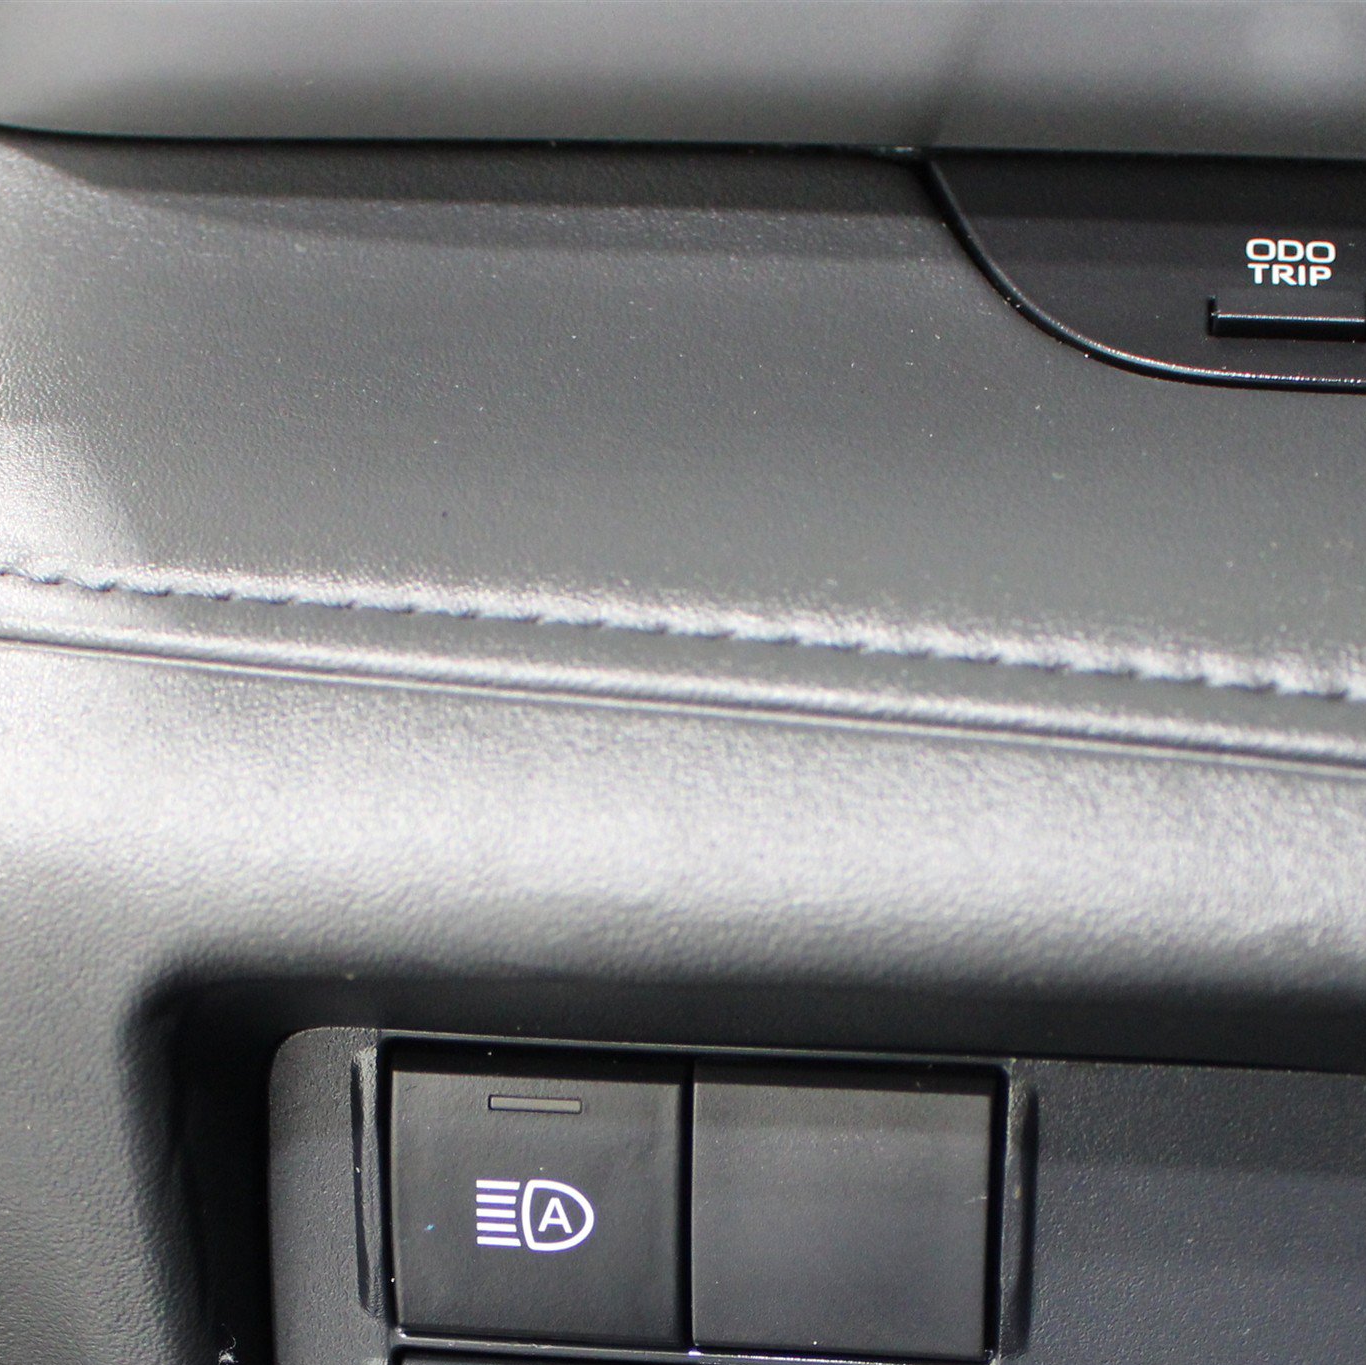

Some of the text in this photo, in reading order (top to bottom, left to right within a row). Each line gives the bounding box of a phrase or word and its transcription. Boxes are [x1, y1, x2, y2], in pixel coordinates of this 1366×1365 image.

[1245, 237, 1337, 264] ODO
[1247, 263, 1332, 287] TRIP
[537, 1197, 573, 1234] A
